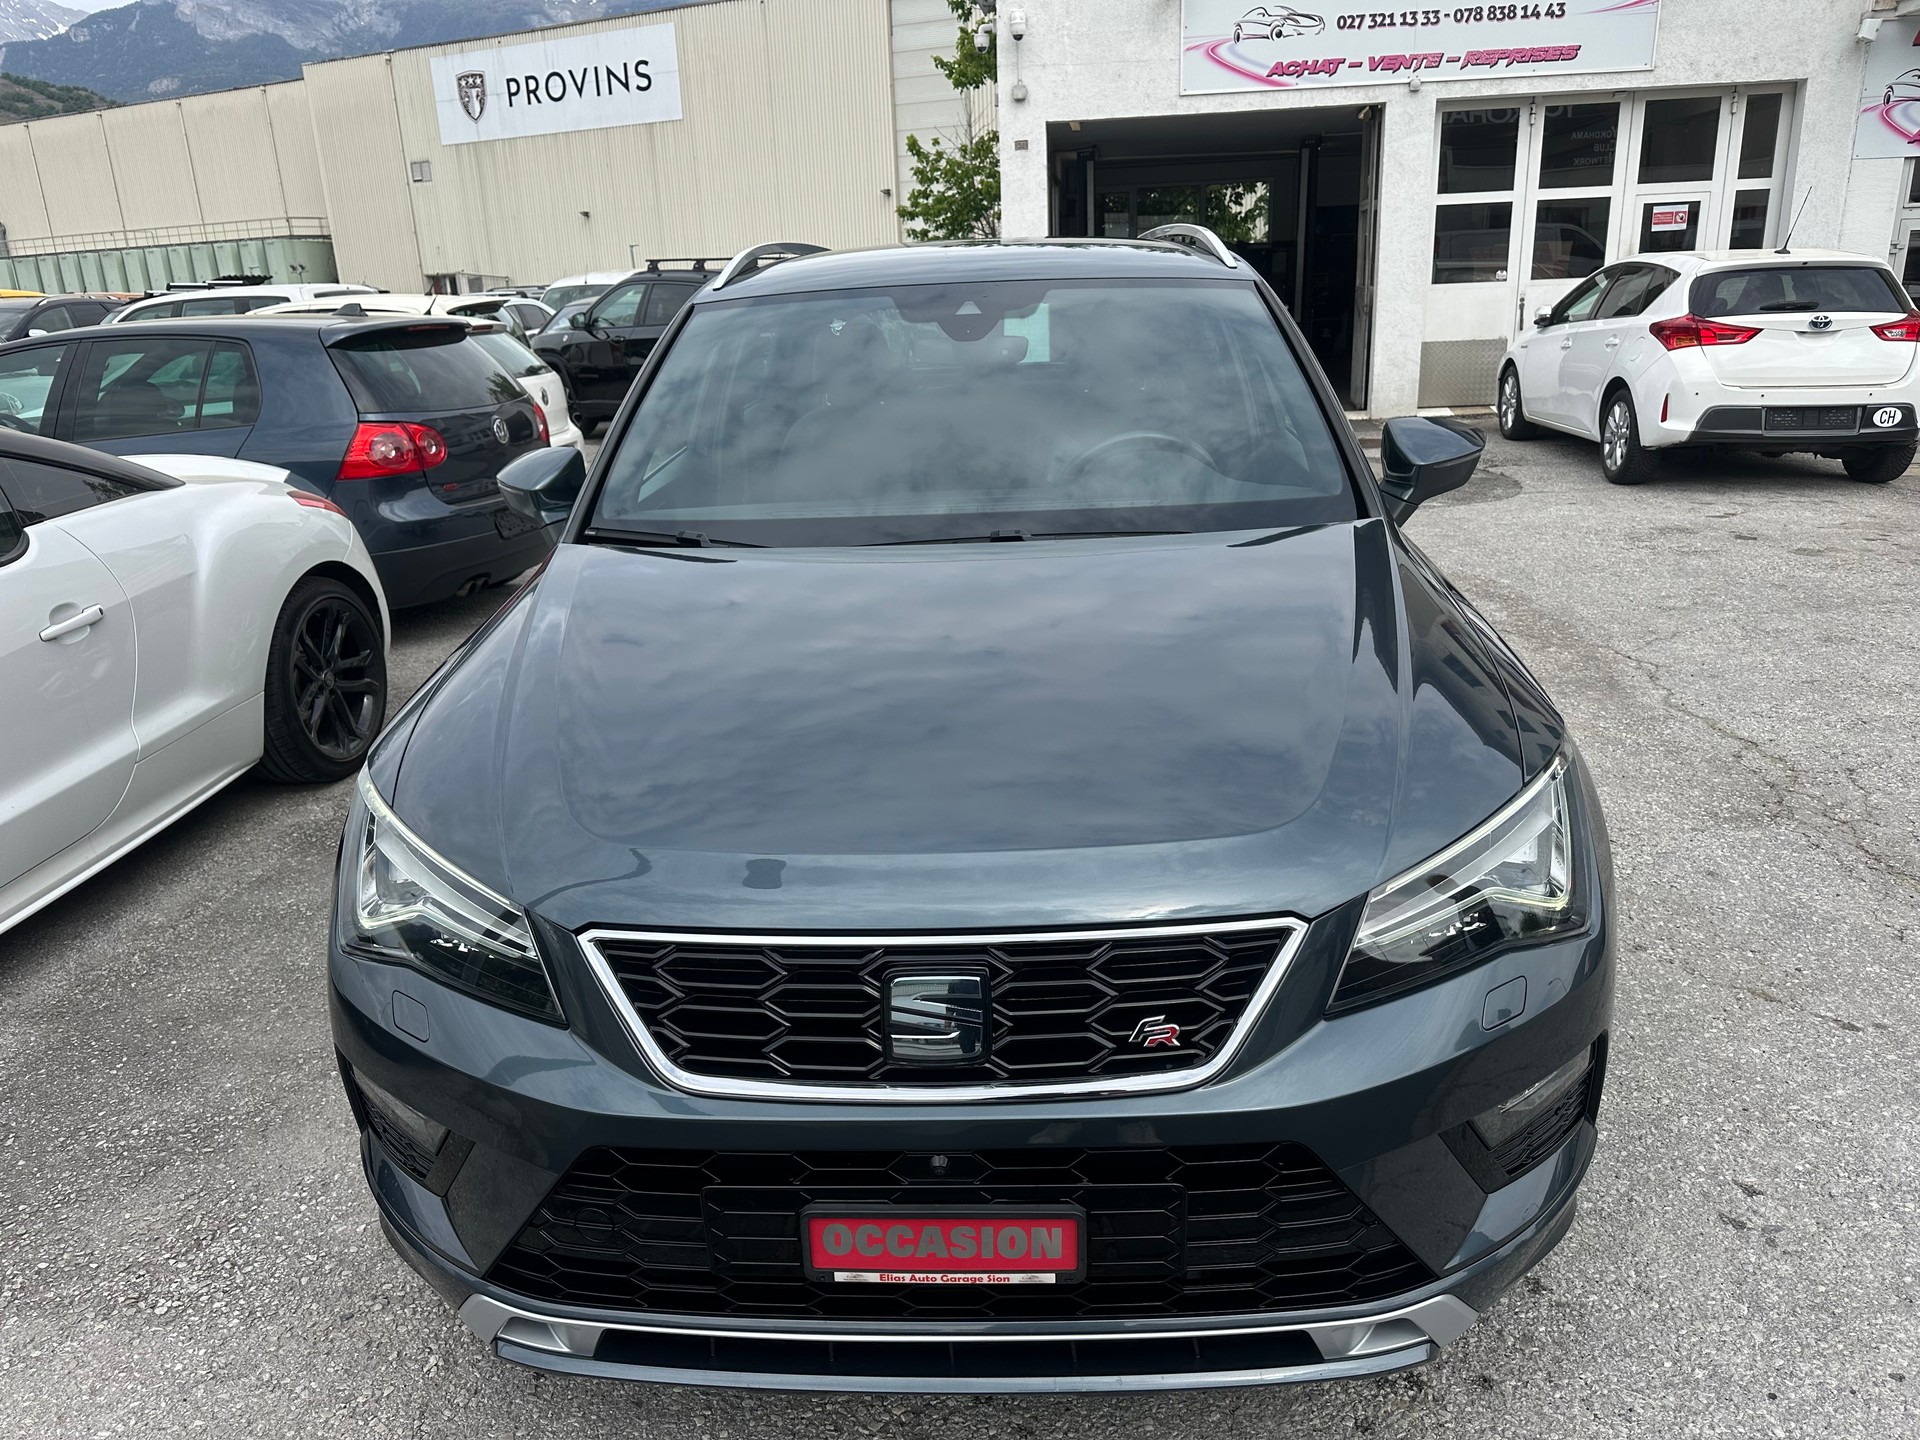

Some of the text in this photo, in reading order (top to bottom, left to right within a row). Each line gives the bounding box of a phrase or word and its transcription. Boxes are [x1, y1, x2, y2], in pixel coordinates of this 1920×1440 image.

[1336, 14, 1365, 30] 027
[1367, 12, 1396, 29] 321
[1399, 11, 1418, 27] 13
[1420, 10, 1441, 26] 33
[1453, 6, 1484, 24] 078
[1486, 4, 1517, 22] 838
[1520, 4, 1541, 20] 14
[1544, 2, 1566, 19] 43
[1266, 58, 1346, 78] ACHAT
[1368, 53, 1444, 73] VENTE
[1460, 45, 1582, 70] REPRISES
[506, 60, 652, 107] PROVINS
[1879, 410, 1896, 425] CH
[1128, 1014, 1181, 1047] FR
[822, 1223, 1063, 1259] OCCASION
[879, 1273, 906, 1282] Elias
[909, 1274, 937, 1283] Auto
[940, 1274, 984, 1284] Garage
[987, 1274, 1010, 1283] Sion
